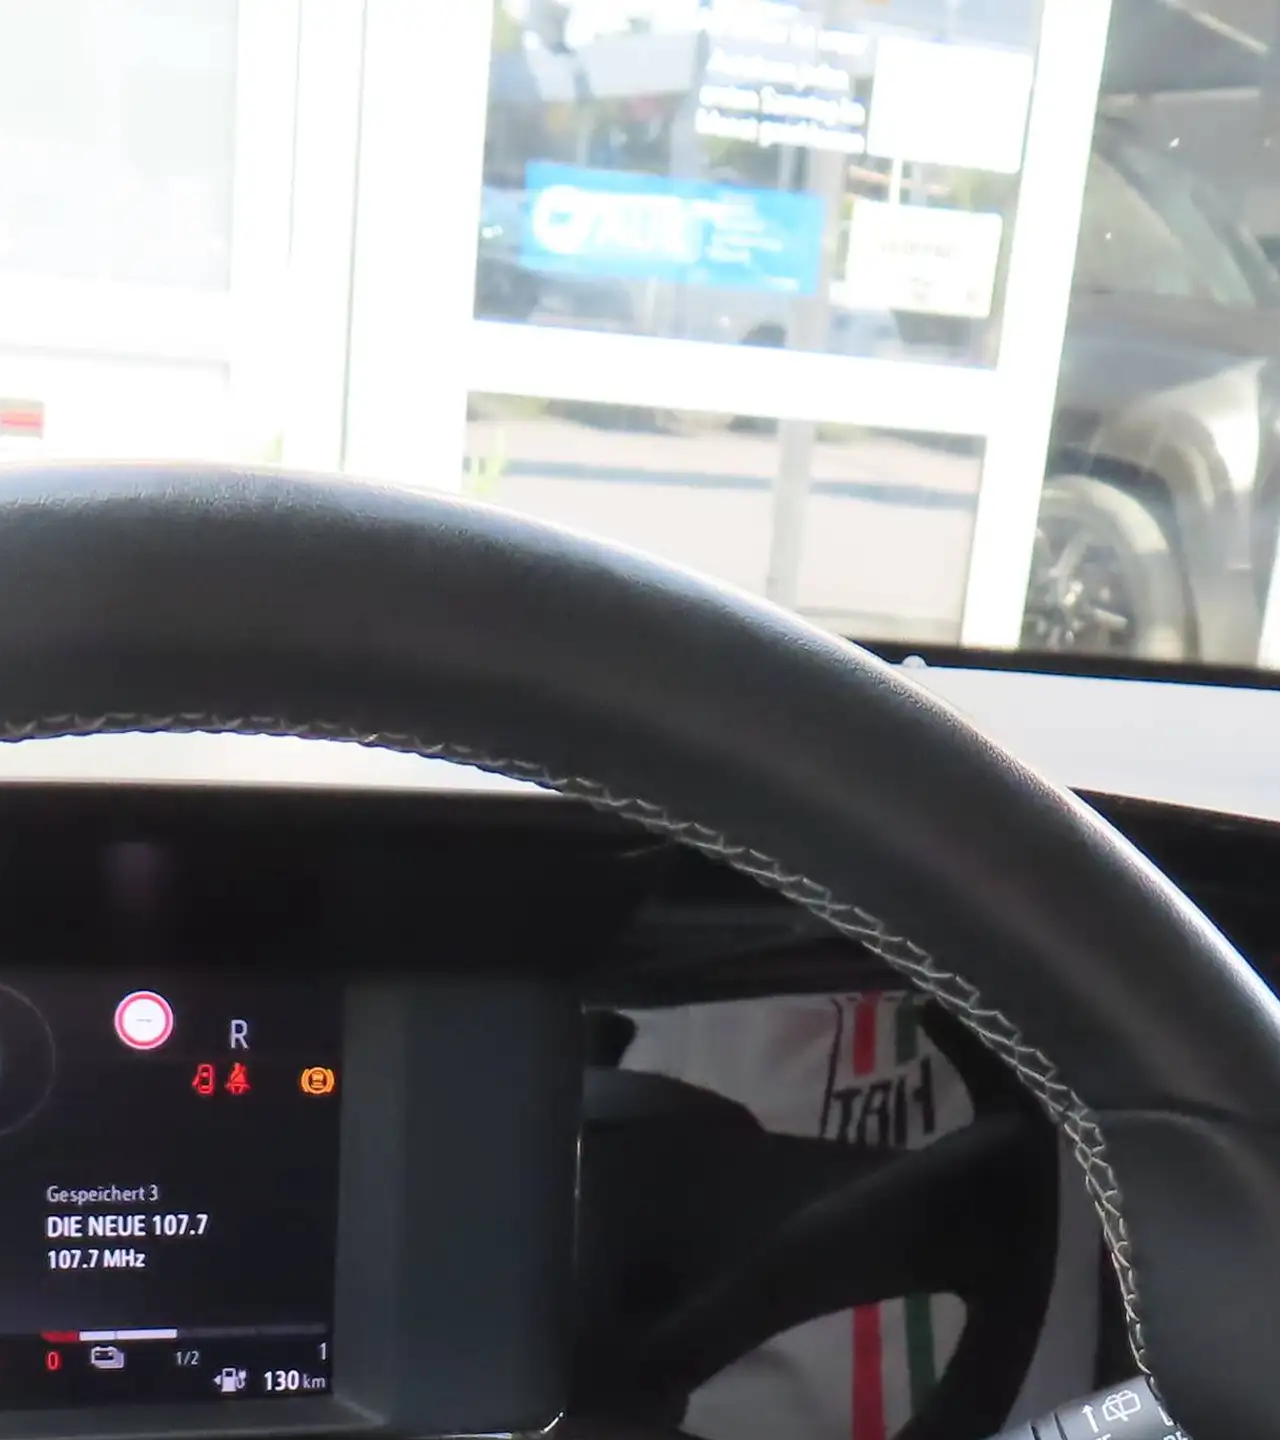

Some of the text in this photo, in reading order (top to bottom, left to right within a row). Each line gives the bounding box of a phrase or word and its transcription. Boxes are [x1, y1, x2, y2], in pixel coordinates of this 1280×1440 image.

[230, 1019, 250, 1049] R
[47, 1184, 159, 1206] Gespeichert 3
[47, 1214, 209, 1238] DIE NEUE 107.7
[48, 1249, 146, 1269] 107.7 MHz
[47, 1352, 59, 1370] 0
[175, 1351, 199, 1365] 1/2
[263, 1370, 326, 1391] 130 km
